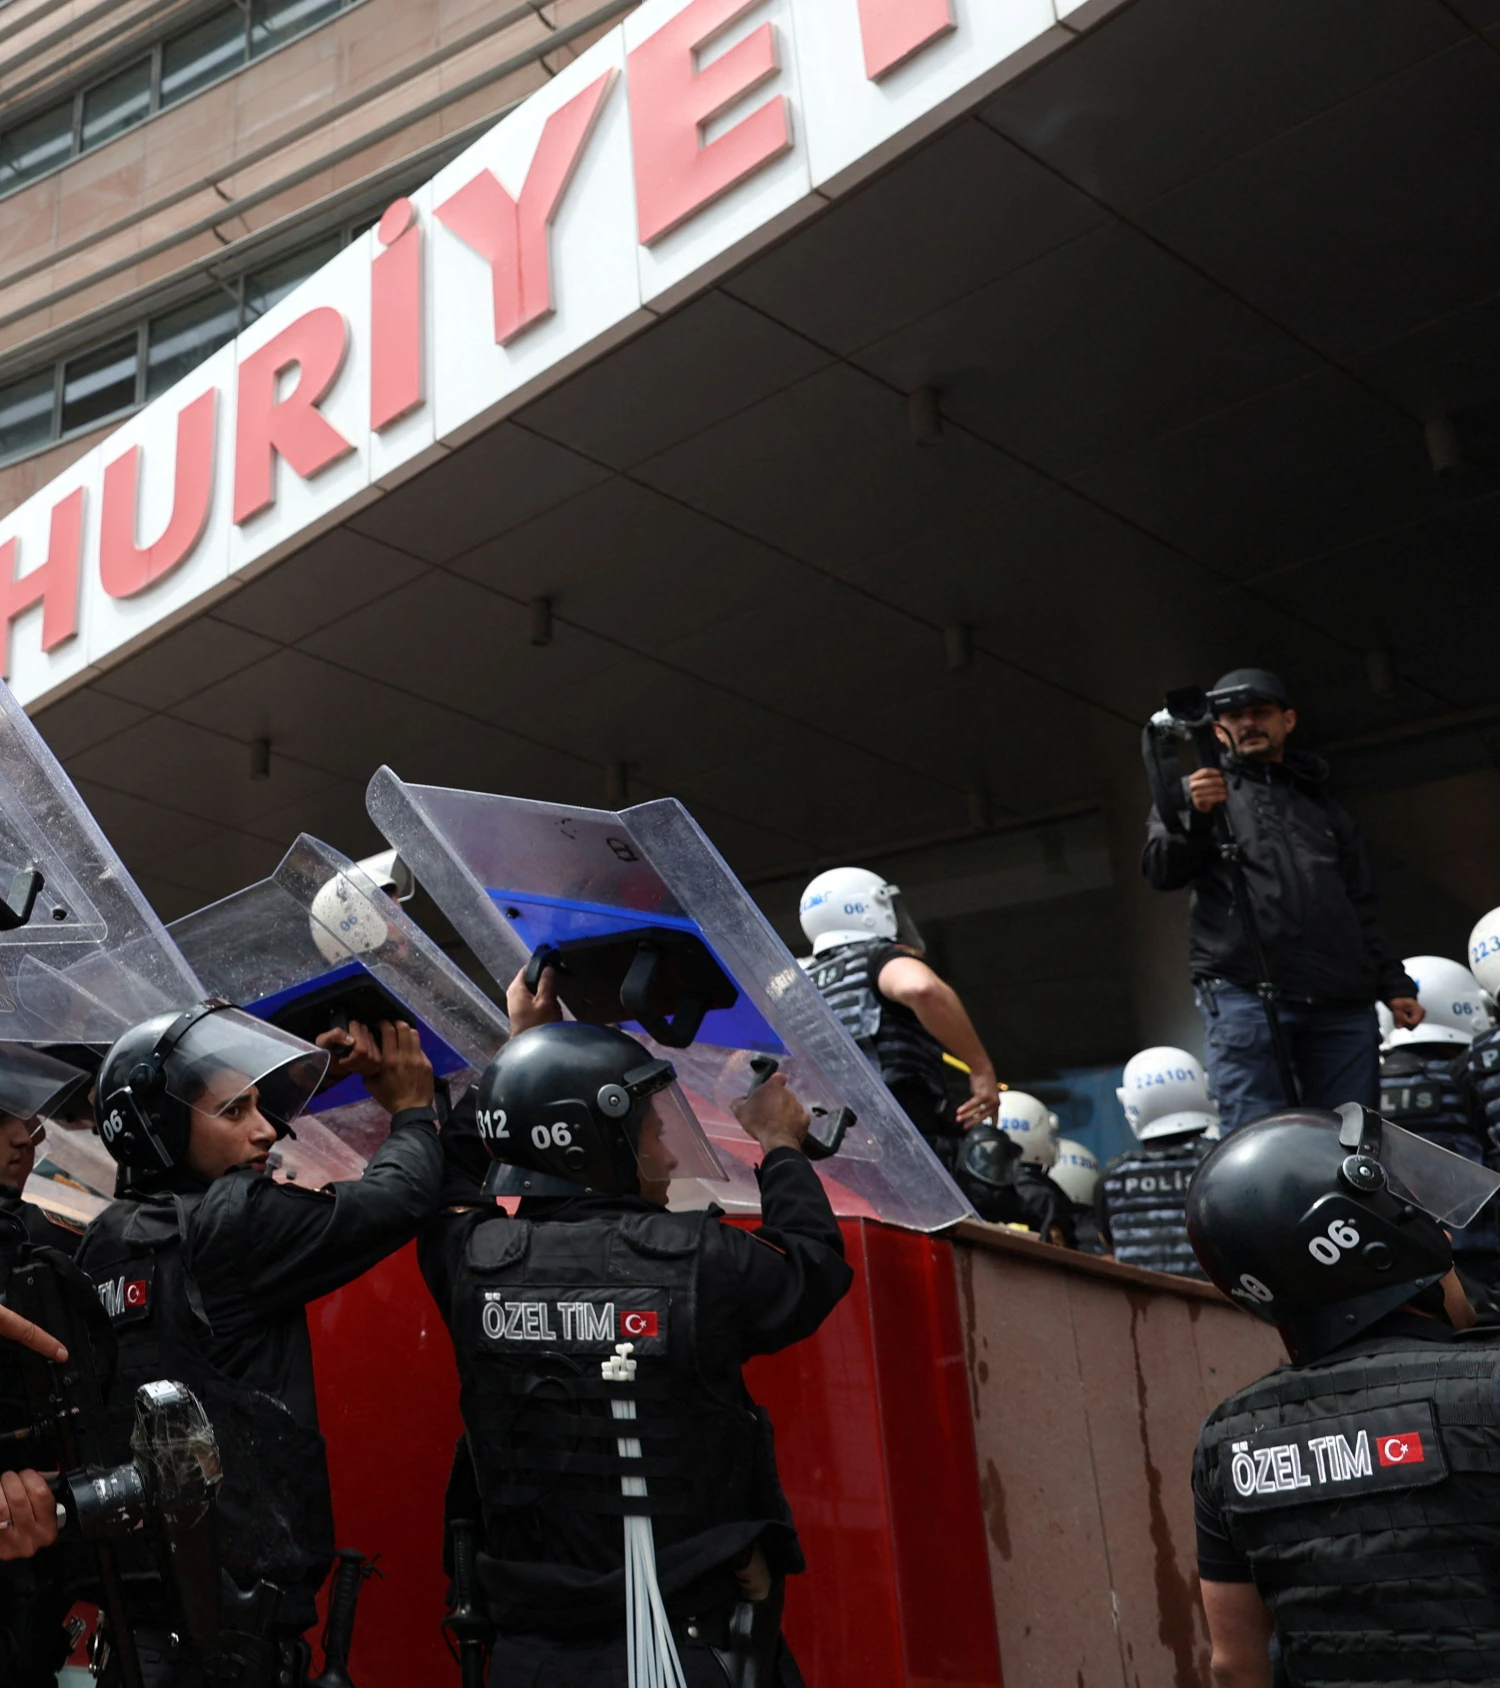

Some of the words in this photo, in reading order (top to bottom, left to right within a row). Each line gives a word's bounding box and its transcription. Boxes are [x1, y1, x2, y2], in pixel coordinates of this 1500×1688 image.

[843, 902, 866, 915] 06
[102, 1109, 123, 1142] 06
[531, 1122, 572, 1149] 06
[1308, 1219, 1360, 1265] 06
[482, 1292, 557, 1340] ÖZEL
[557, 1302, 616, 1341] TİM
[1232, 1440, 1311, 1497] ÖZEL
[1308, 1429, 1373, 1484] TİM
